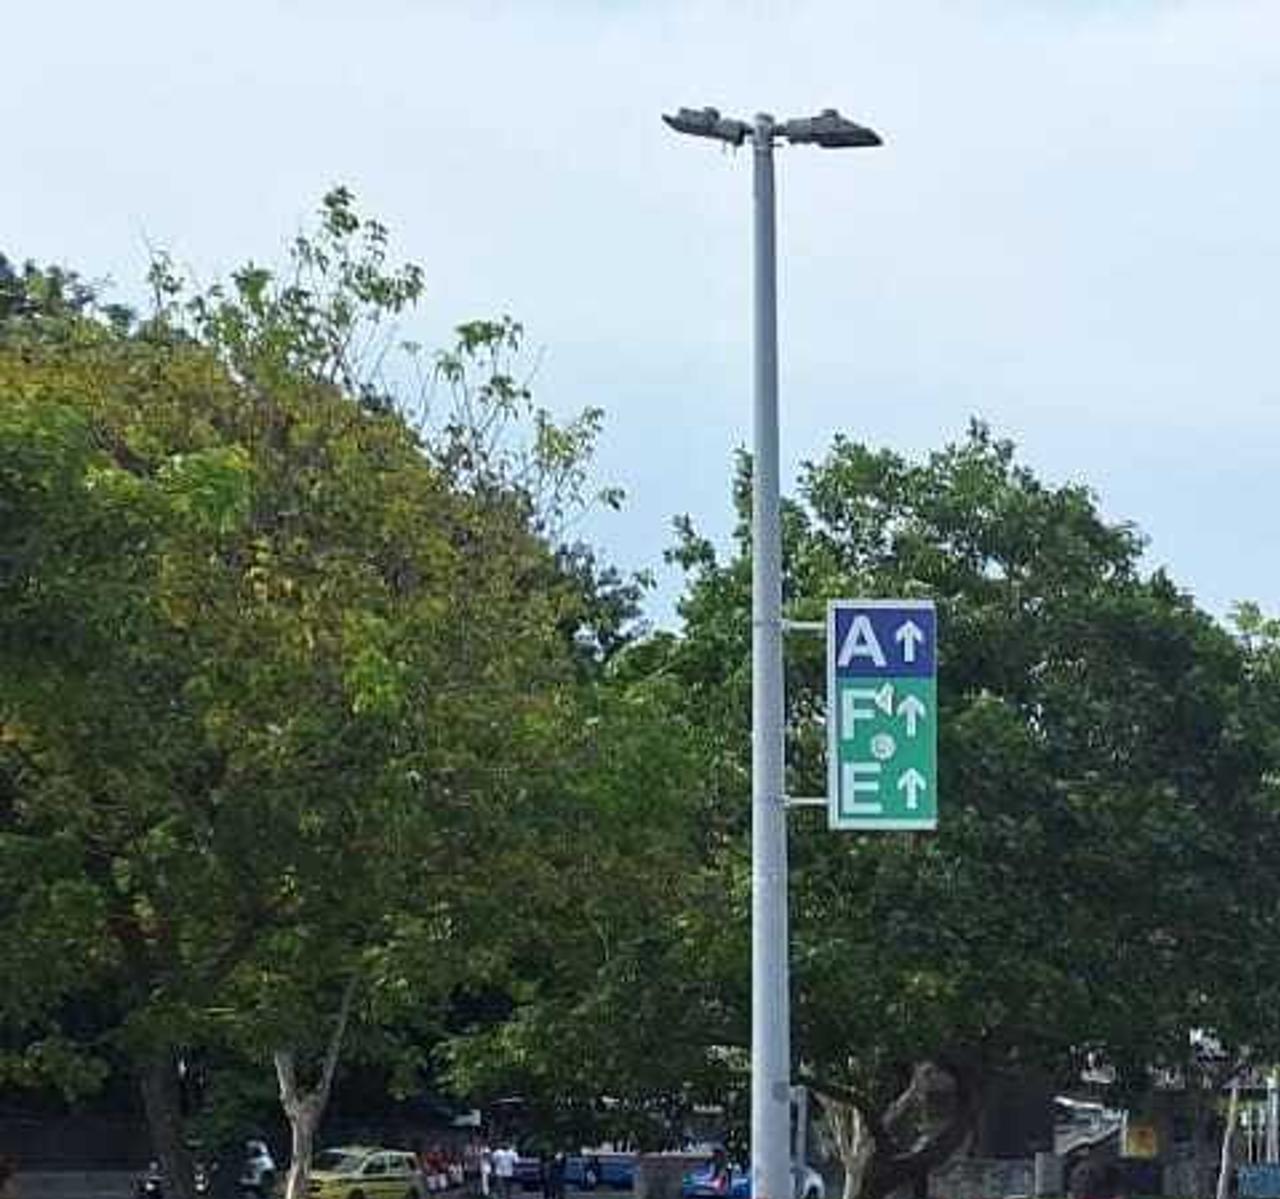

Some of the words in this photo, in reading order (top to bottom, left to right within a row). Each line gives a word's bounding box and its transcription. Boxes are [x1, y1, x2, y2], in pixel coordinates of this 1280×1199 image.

[837, 615, 887, 667] A
[842, 688, 879, 740] F
[842, 762, 883, 814] E
